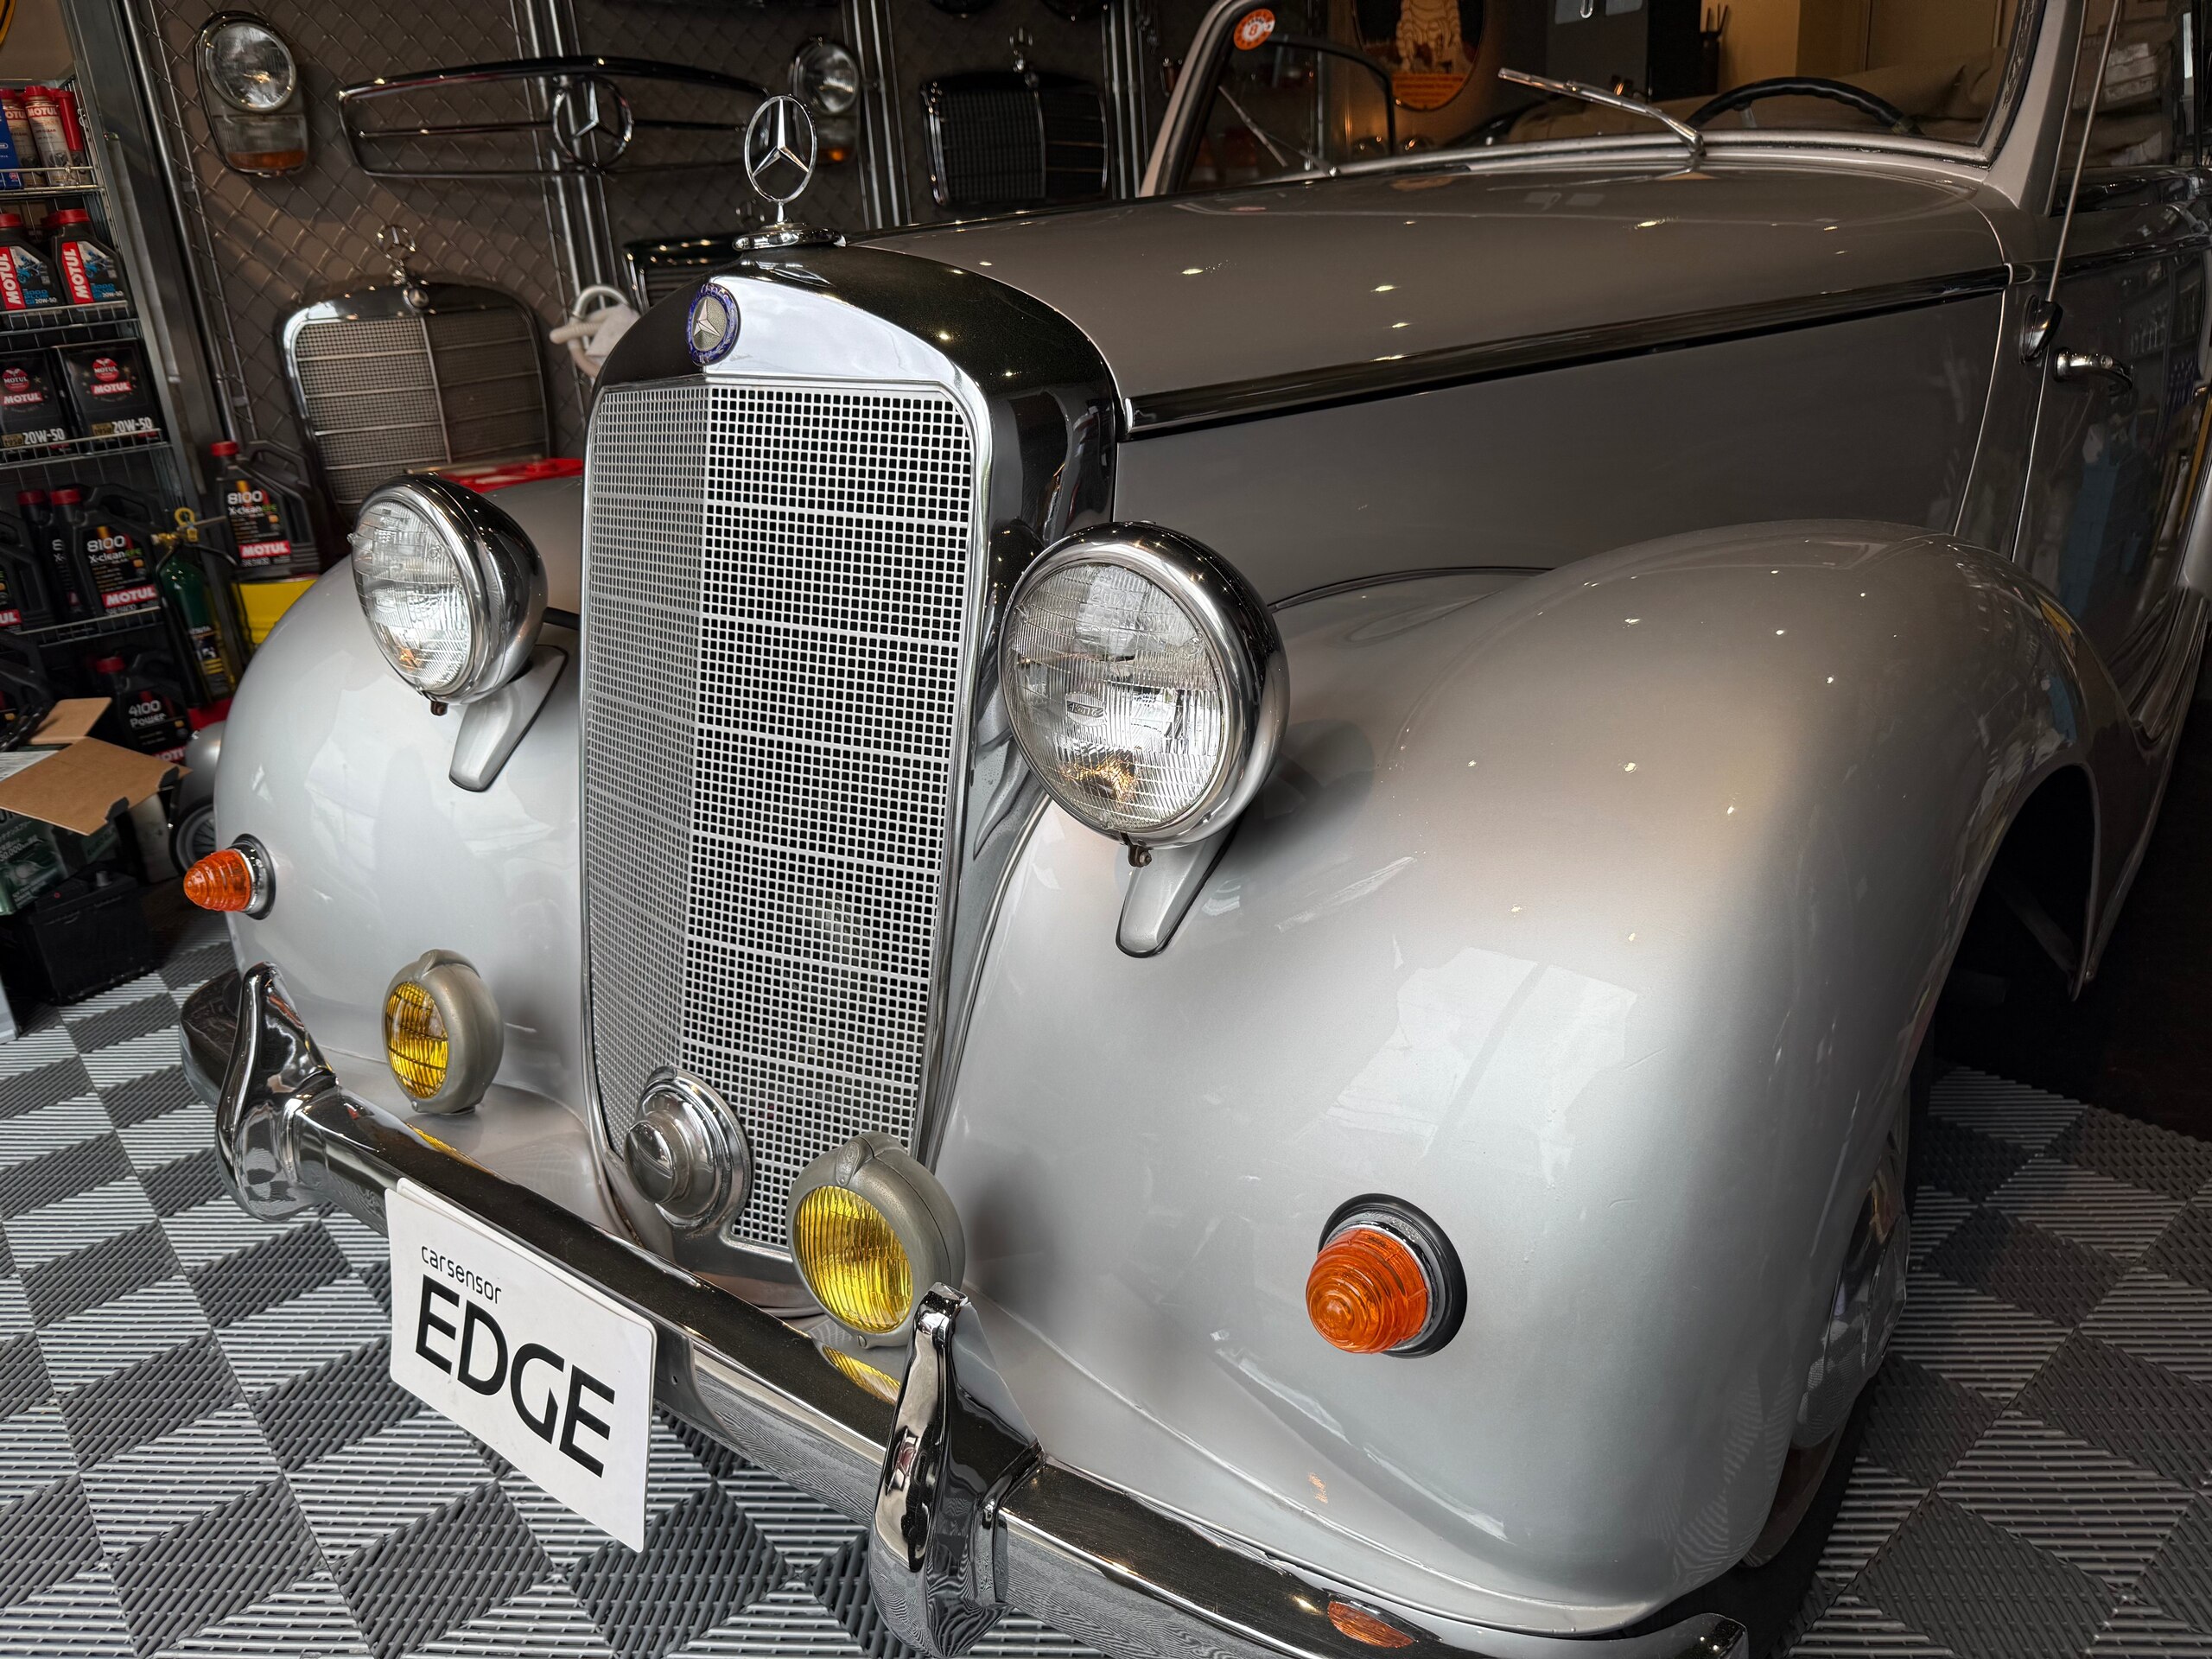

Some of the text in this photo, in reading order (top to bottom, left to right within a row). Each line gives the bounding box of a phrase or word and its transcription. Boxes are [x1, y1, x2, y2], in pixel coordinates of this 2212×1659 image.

[28, 106, 58, 117] MOTUL
[63, 248, 90, 300] MOTUL
[94, 365, 118, 374] MOTUL
[4, 376, 29, 385] MOTUL
[93, 382, 131, 395] MOTUL
[3, 391, 43, 404] MOTUL
[111, 416, 153, 434] 20W-50
[22, 428, 66, 445] 20W-50
[227, 490, 263, 505] 8100
[86, 535, 126, 553] 8100
[242, 542, 289, 558] MOTUL
[106, 586, 157, 607] MOTUL
[128, 700, 162, 716] 4100
[421, 1244, 502, 1305] carsensor
[416, 1274, 615, 1478] EDGE
